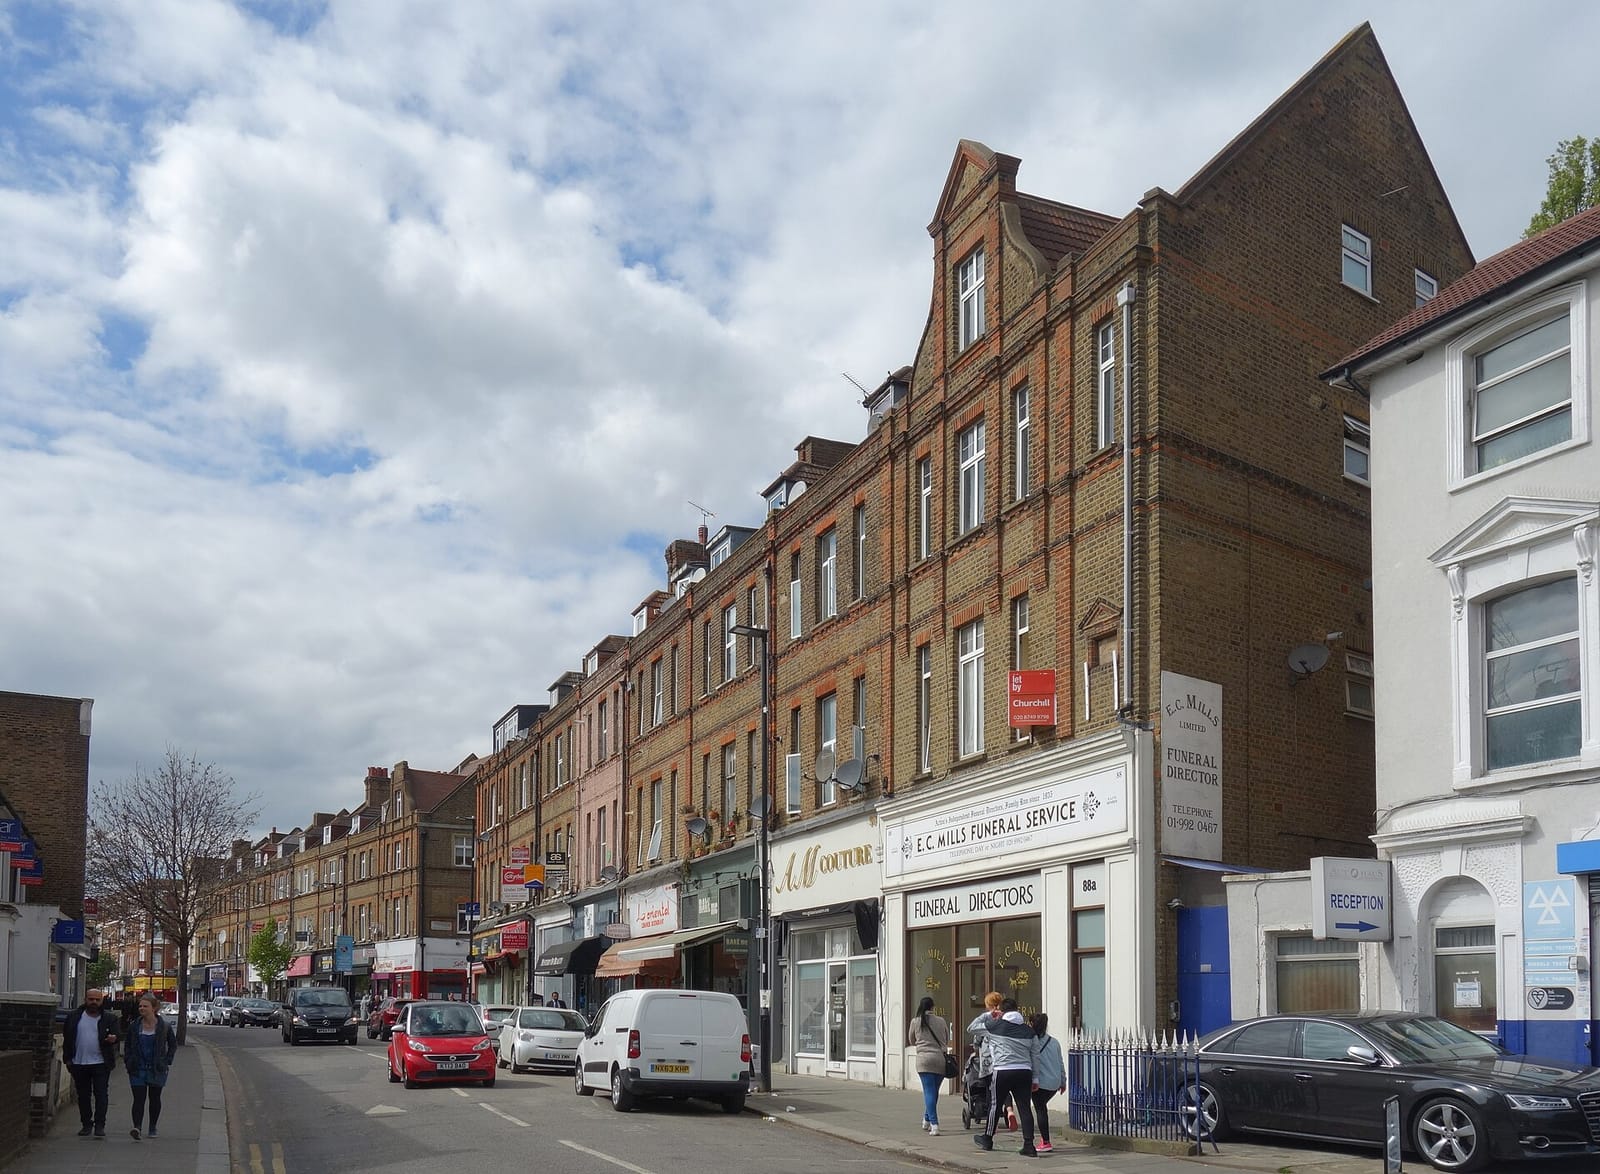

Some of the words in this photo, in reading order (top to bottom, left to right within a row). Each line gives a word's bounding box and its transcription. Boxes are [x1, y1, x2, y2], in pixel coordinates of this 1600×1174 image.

[1012, 674, 1022, 683] let
[1012, 684, 1022, 692] by
[1012, 698, 1050, 707] Churchill
[1186, 694, 1220, 727] MILLS
[1180, 720, 1206, 732] LIMITED
[1167, 748, 1218, 769] FUNERAL
[1167, 765, 1219, 786] DIRECTOR
[1173, 804, 1213, 819] TELEPHONE
[938, 827, 966, 848] MILLS
[971, 814, 1021, 841] FUNERAL
[1026, 801, 1076, 829] SERVICE
[1197, 820, 1218, 834] 0467
[820, 844, 873, 874] COUTURE
[1083, 880, 1096, 892] 88a
[915, 896, 960, 918] FUNERAL
[969, 885, 1033, 912] DIRECTORS
[1331, 894, 1384, 910] RECEPTION
[928, 948, 950, 972] MILLS
[1014, 941, 1041, 968] MILLS
